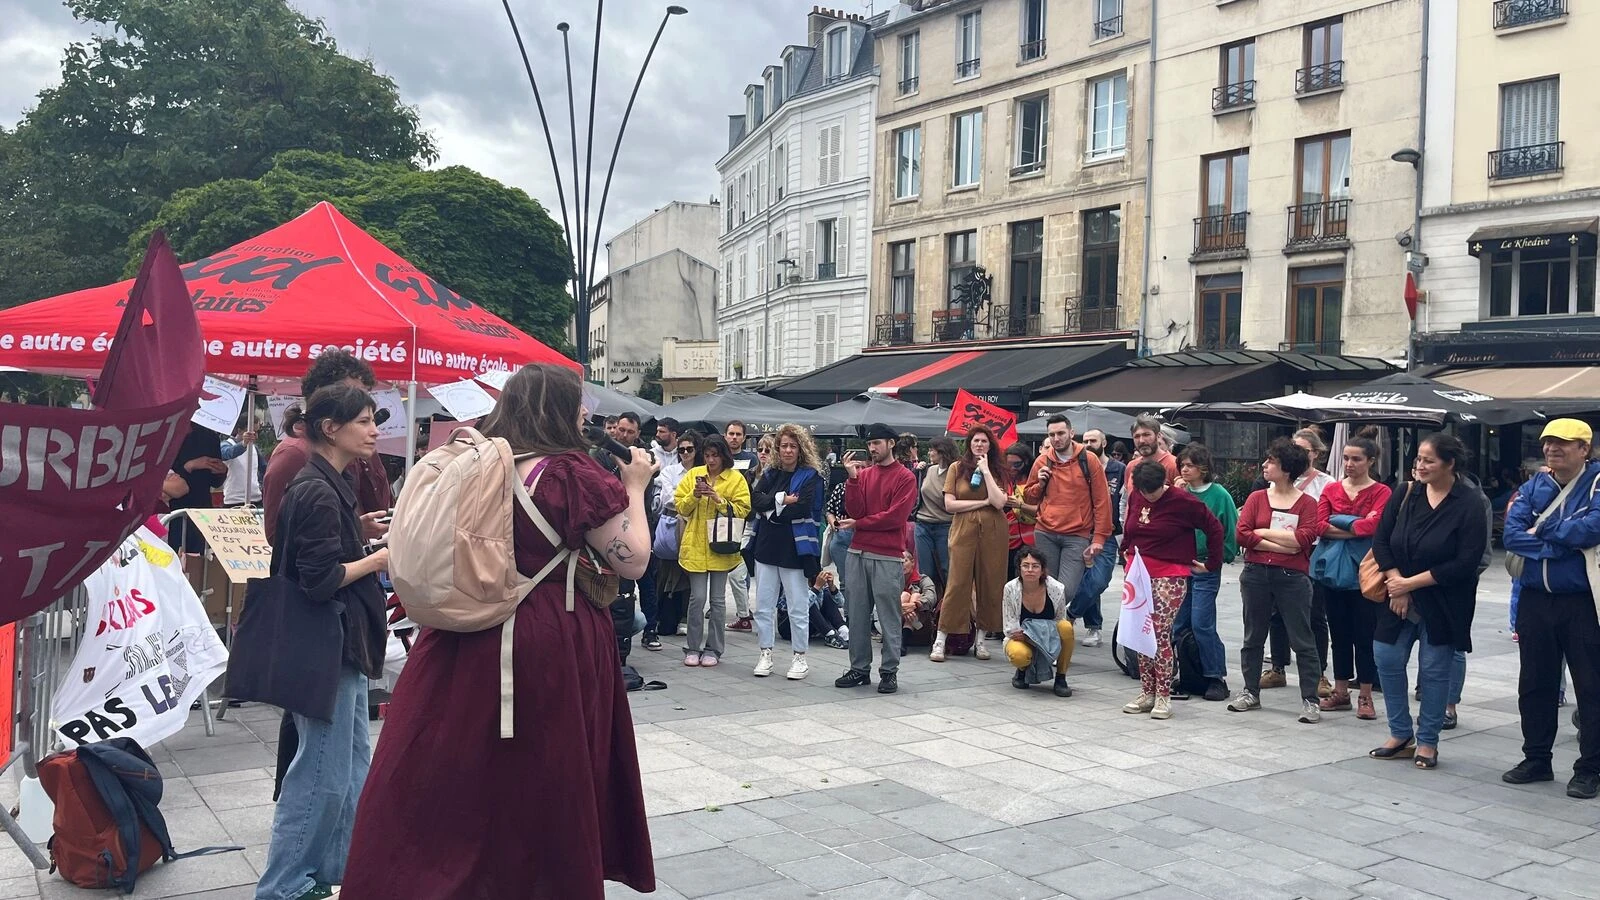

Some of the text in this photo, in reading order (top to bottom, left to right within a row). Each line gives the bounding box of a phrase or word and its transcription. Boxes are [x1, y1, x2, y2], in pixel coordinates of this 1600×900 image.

[1500, 236, 1550, 249] Le Khedive
[20, 332, 86, 351] autre
[230, 339, 302, 359] autre
[417, 347, 443, 366] une
[445, 352, 478, 371] autre
[240, 545, 272, 556] VSS
[59, 697, 138, 746] PAS
